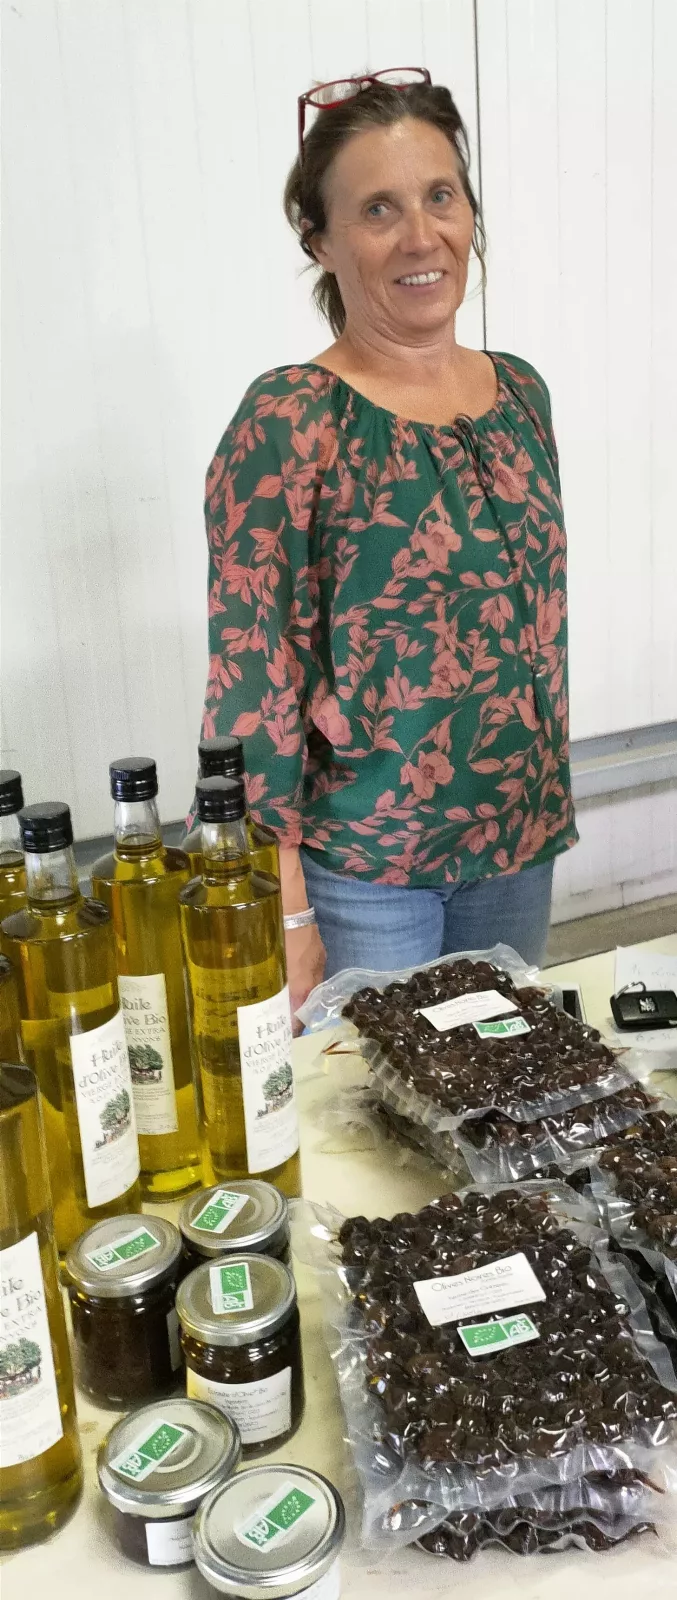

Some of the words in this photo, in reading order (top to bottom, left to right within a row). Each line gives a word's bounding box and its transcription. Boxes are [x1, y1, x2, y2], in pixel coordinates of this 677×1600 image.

[144, 1012, 167, 1026] Bio
[255, 1014, 287, 1039] Huile
[90, 1040, 122, 1067] Huile
[431, 1281, 464, 1292] Olives
[463, 1271, 494, 1284] Noires
[16, 1290, 42, 1312] Bio
